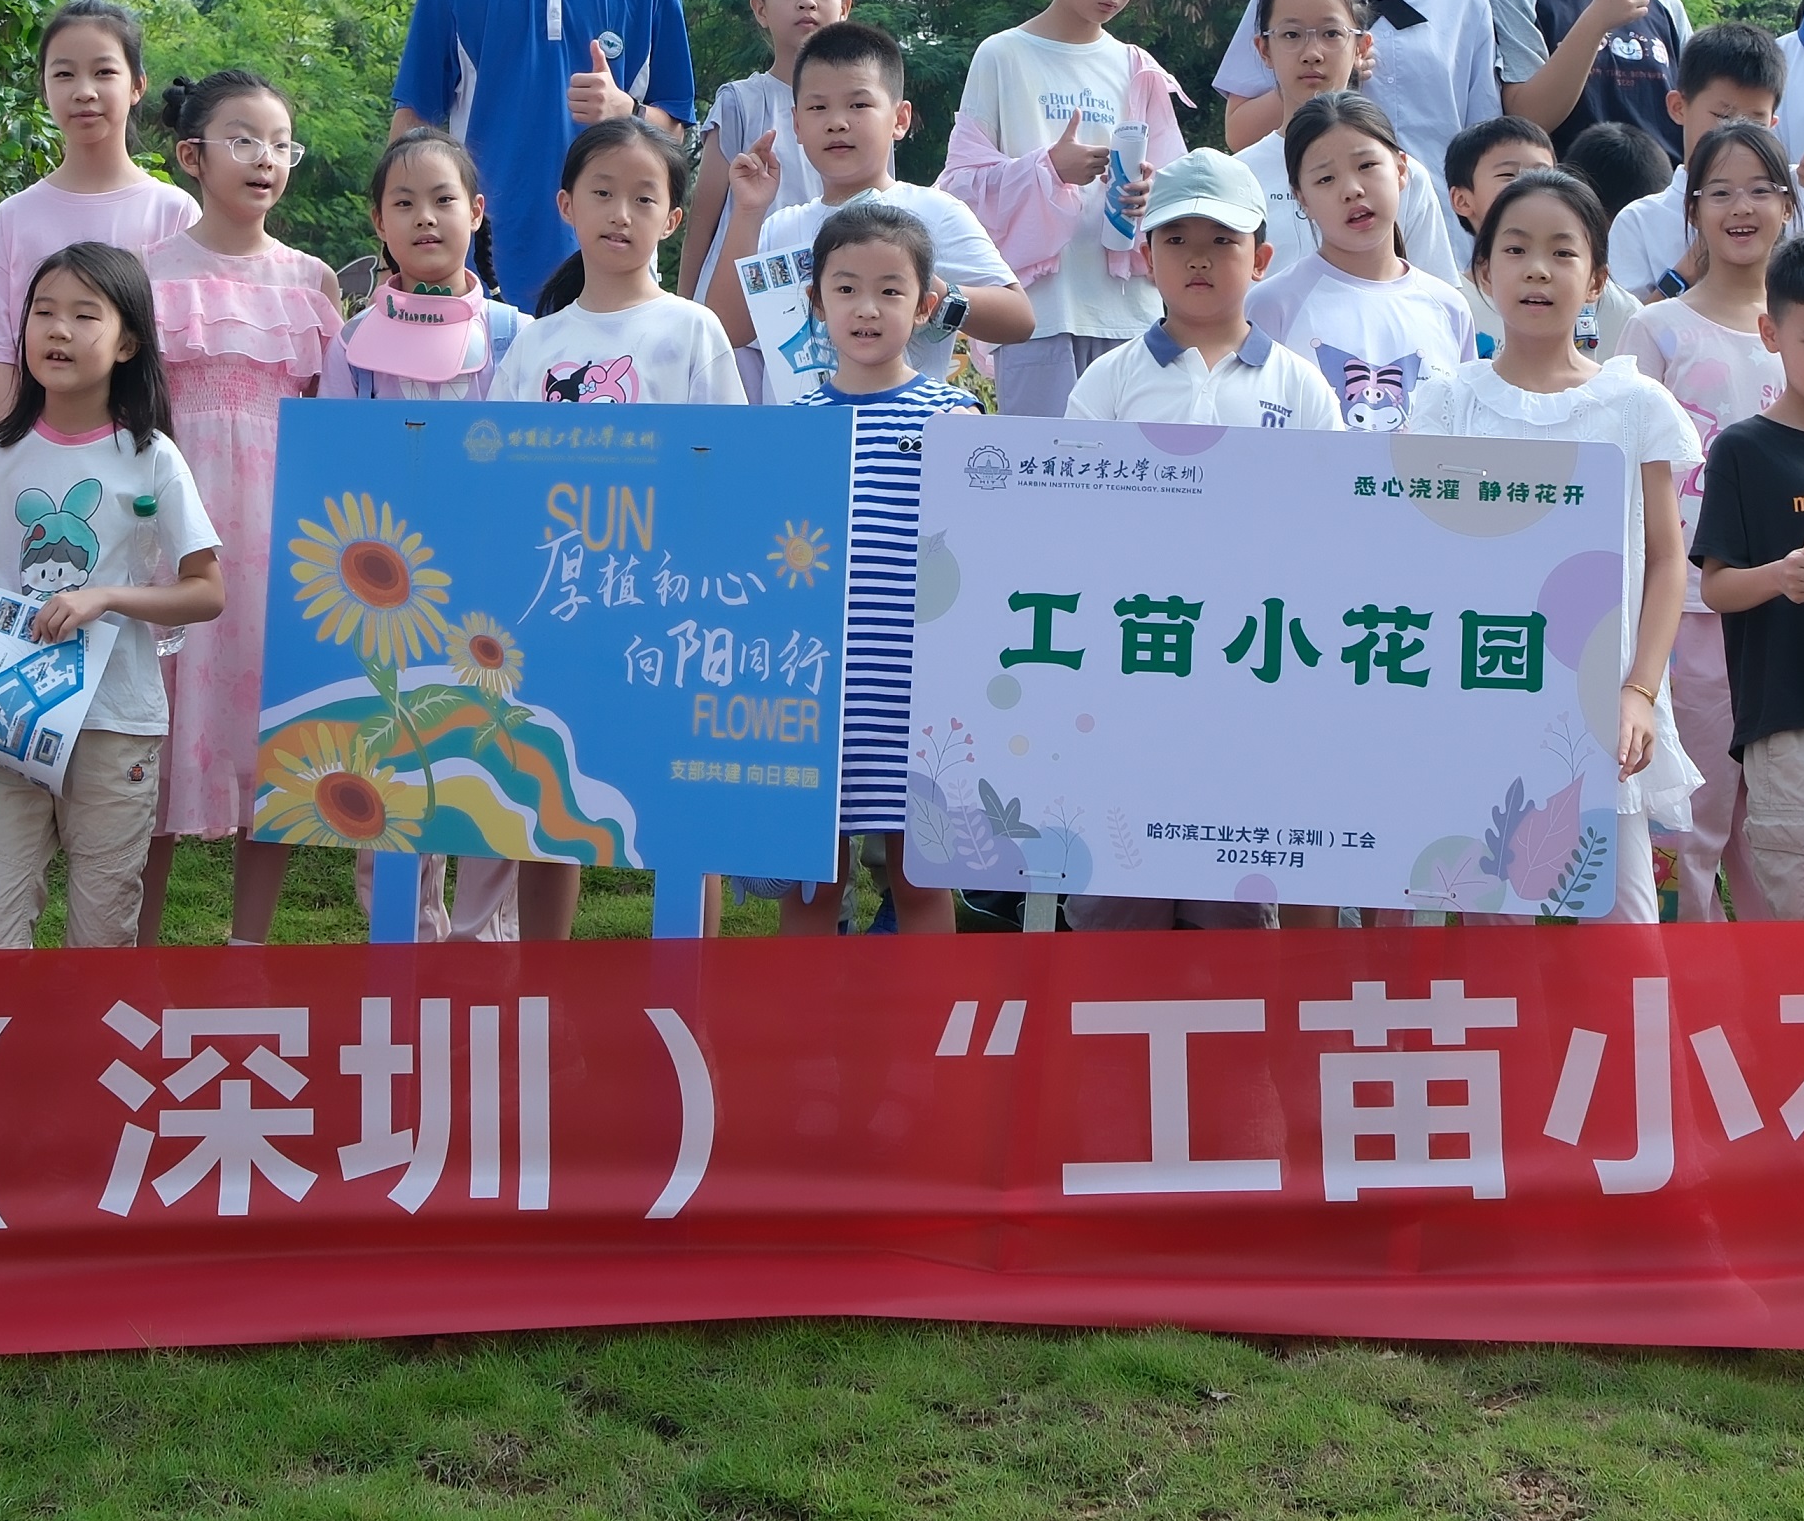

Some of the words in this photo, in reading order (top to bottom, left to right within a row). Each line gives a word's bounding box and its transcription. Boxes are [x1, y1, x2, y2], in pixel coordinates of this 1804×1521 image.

[1049, 92, 1075, 105] But
[1045, 105, 1115, 126] kinness
[1270, 193, 1284, 201] no
[1259, 399, 1293, 418] VITALITY
[1017, 480, 1047, 488] HARBIN
[1049, 482, 1091, 490] INSTITUTE
[1160, 486, 1203, 495] SHENZHEN
[1354, 476, 1460, 500] 悉心浇灌
[1478, 480, 1585, 506] 静待花开
[544, 482, 656, 553] SUN
[517, 528, 767, 625] 厚植初心
[999, 589, 1547, 693] 工苗小花园
[623, 619, 831, 695] 向阳同行
[692, 693, 821, 744] FLOWER
[671, 760, 741, 784] 支部共建
[747, 764, 820, 788] 向日葵园
[1146, 822, 1377, 850] 哈尔滨工业大学（深圳）工会
[1216, 848, 1305, 869] 2025年7月
